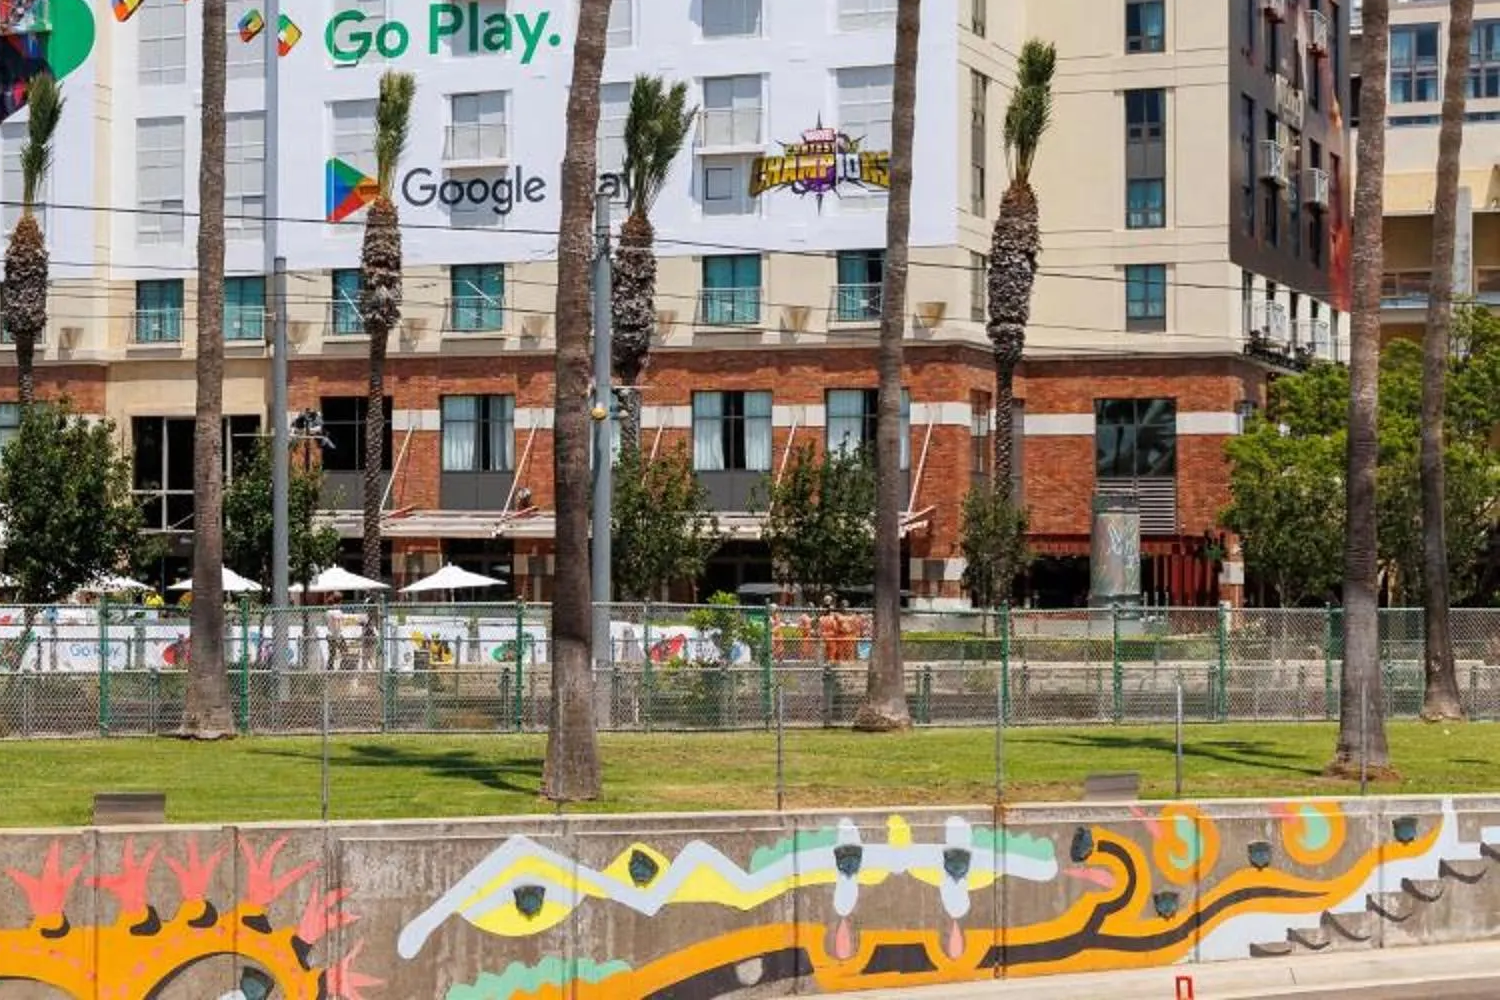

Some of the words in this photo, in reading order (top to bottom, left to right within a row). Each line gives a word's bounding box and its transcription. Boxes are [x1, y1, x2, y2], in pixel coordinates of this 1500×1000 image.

[325, 9, 409, 64] Go
[428, 2, 561, 65] Play.
[401, 165, 547, 215] Google
[750, 150, 891, 197] CHAMPIONS
